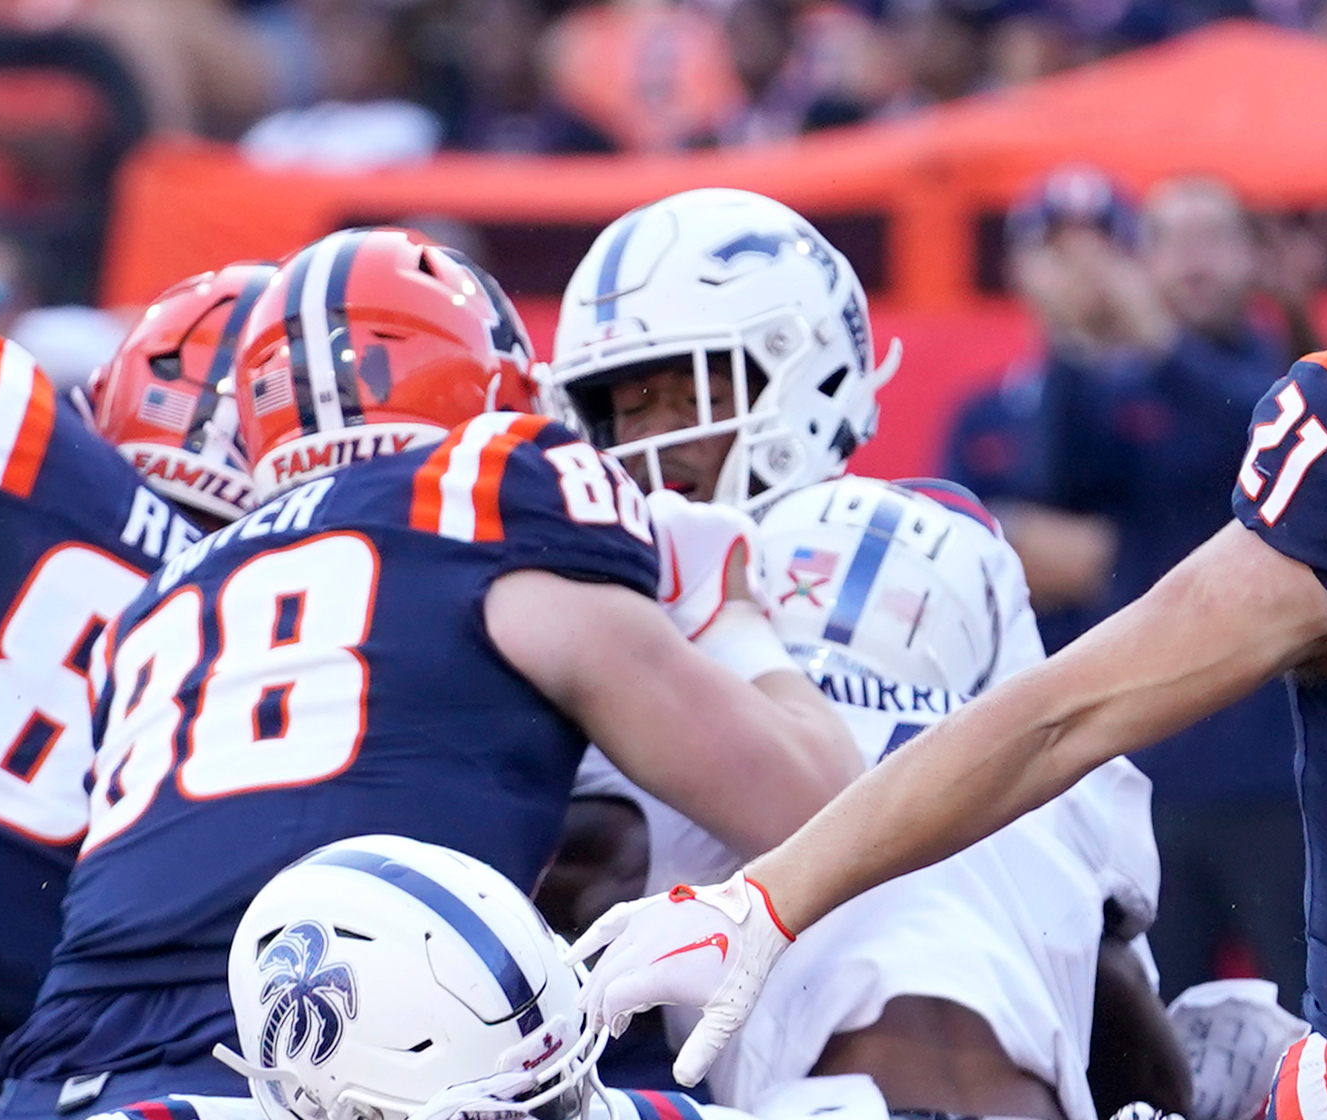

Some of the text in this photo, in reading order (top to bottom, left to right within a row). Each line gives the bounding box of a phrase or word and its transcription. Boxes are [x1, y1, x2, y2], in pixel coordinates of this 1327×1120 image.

[135, 454, 261, 511] FAMILL
[76, 530, 380, 862] 88
[807, 672, 971, 714] MORRI
